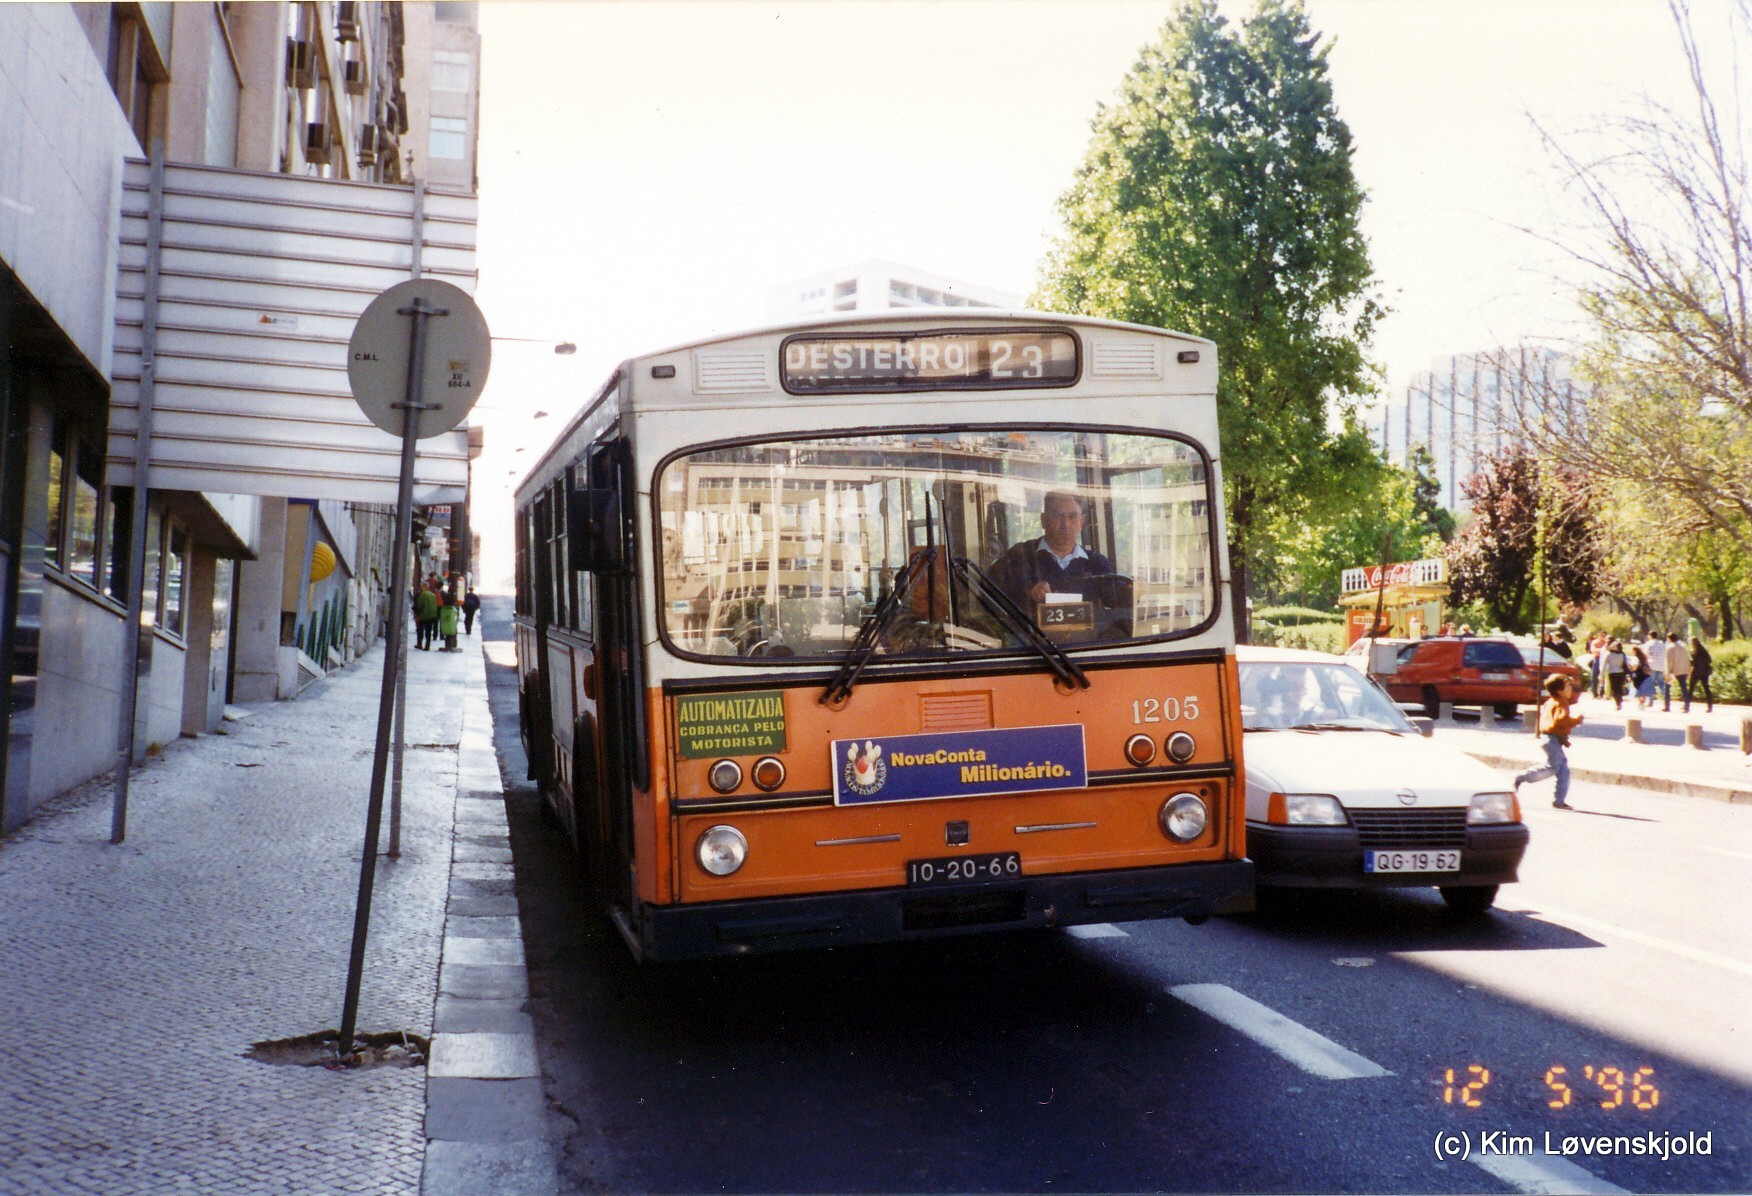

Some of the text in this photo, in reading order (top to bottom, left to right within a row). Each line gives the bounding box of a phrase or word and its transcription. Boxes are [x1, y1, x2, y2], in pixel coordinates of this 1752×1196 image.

[785, 340, 1043, 378] DESTERRO 23
[680, 697, 784, 722] AUTOMATIZADA
[1132, 695, 1199, 725] 1205
[680, 721, 785, 737] COBRANÇA PELO
[691, 736, 773, 750] MOTORISTA
[891, 748, 986, 767] NovaConta
[961, 761, 1071, 783] Milionário.
[912, 855, 1018, 883] 10-20-66
